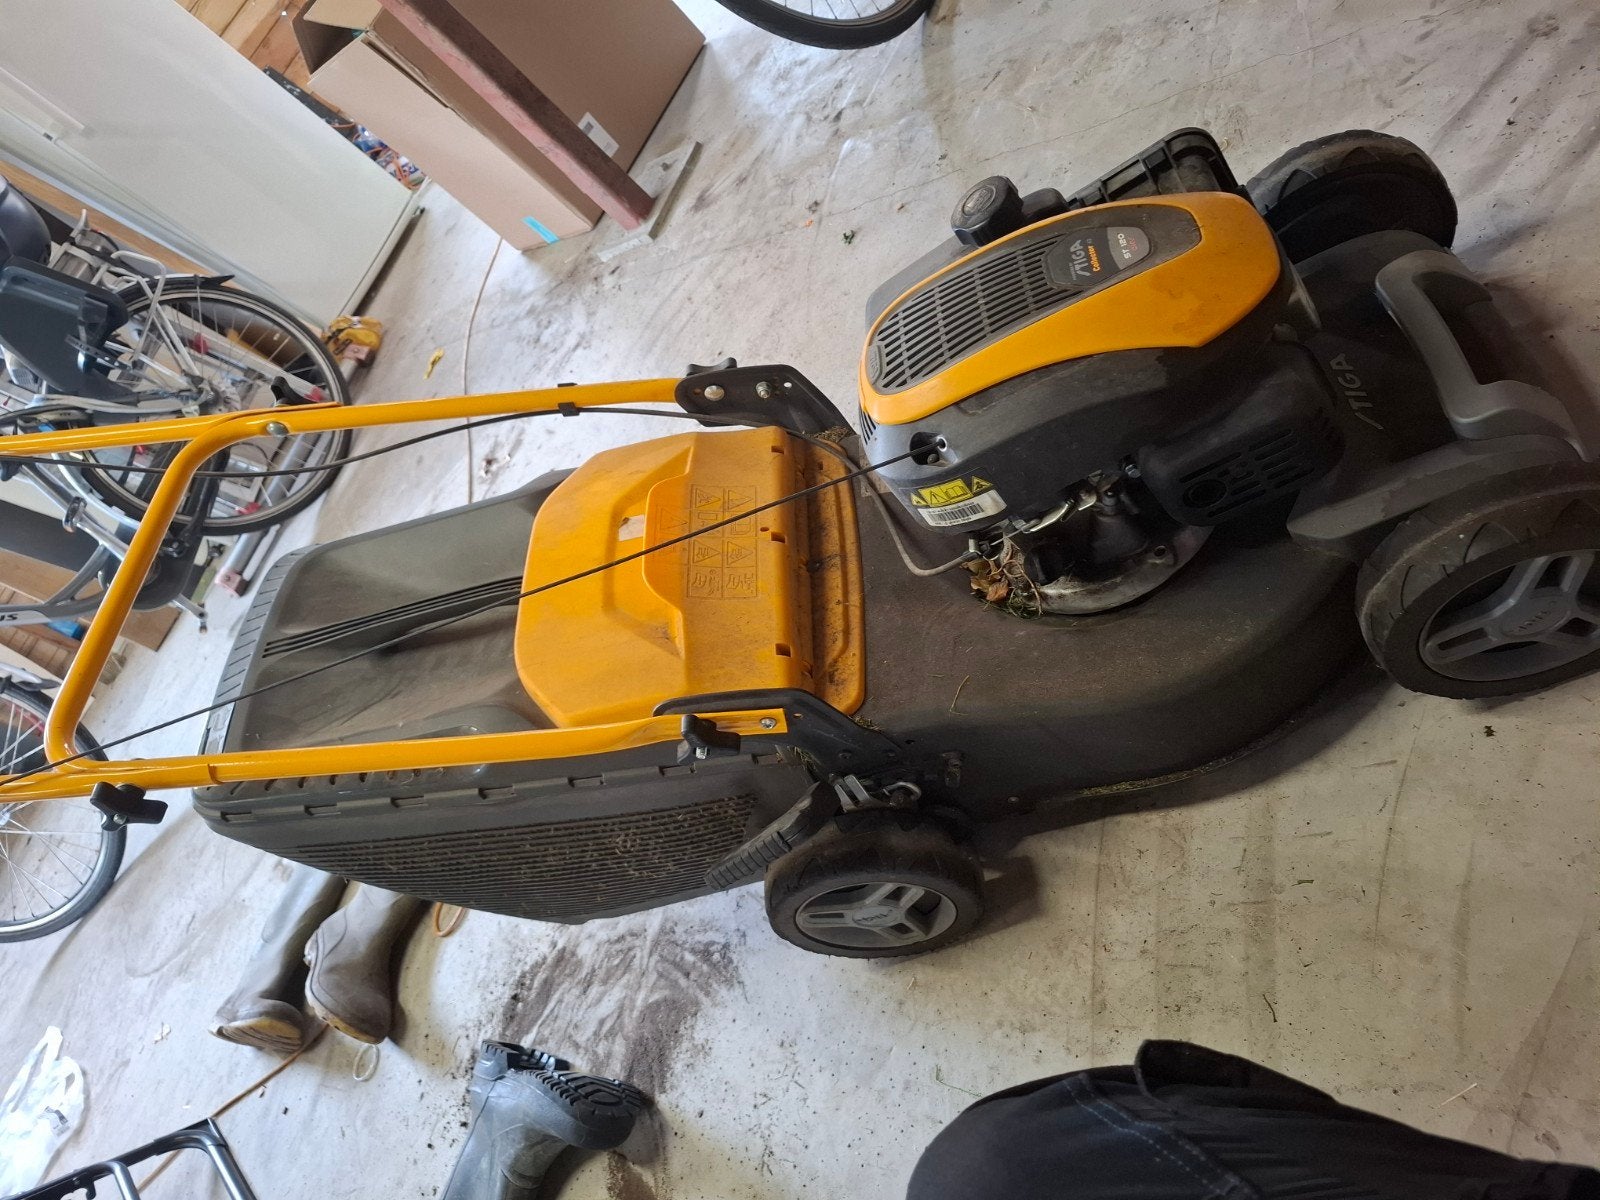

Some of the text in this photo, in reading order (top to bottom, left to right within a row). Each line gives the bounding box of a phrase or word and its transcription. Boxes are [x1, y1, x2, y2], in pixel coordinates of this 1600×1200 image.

[1070, 240, 1091, 276] STIGA
[1087, 245, 1100, 272] Collector
[1117, 233, 1131, 259] ST 120
[1329, 353, 1384, 429] STIGA
